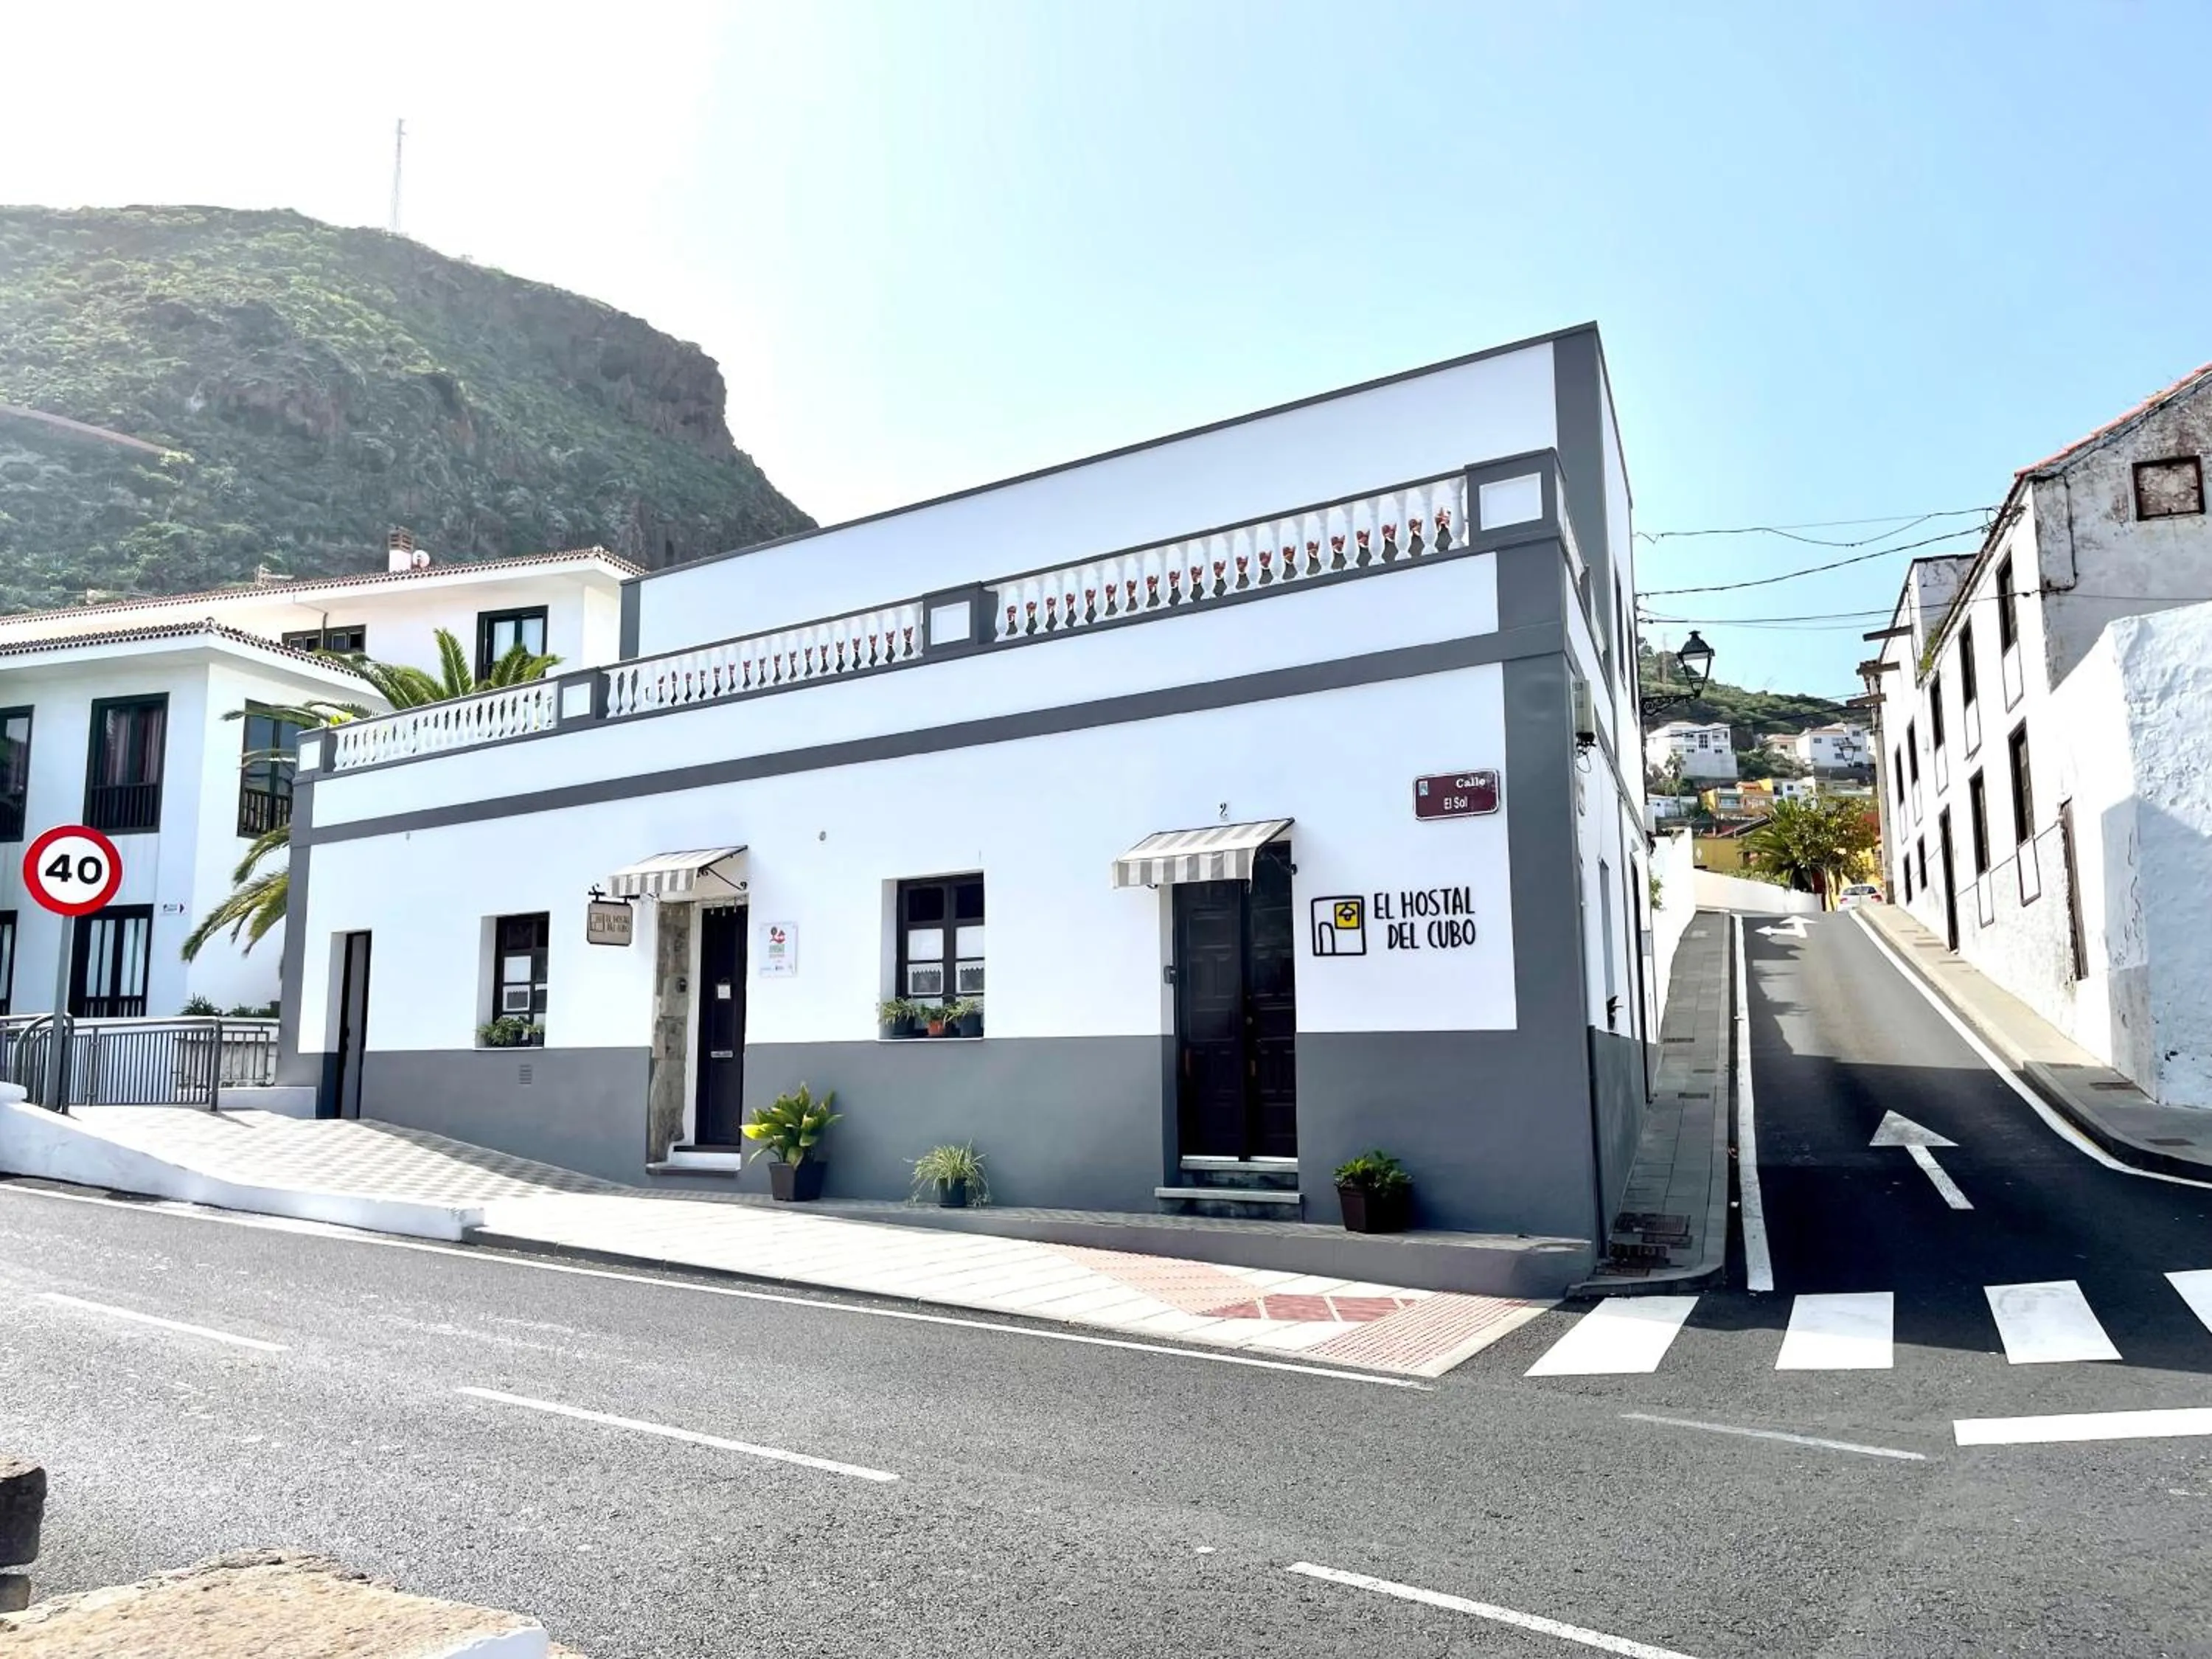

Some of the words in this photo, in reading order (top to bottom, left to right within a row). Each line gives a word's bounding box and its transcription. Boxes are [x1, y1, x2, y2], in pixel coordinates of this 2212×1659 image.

[1455, 776, 1486, 788] Calle
[1444, 797, 1452, 810] El
[1453, 796, 1468, 809] Sol
[45, 854, 102, 885] 40
[1374, 893, 1394, 919] EL
[1400, 886, 1475, 918] HOSTAL
[1388, 922, 1419, 949] DEL
[1427, 919, 1475, 948] CUBO
